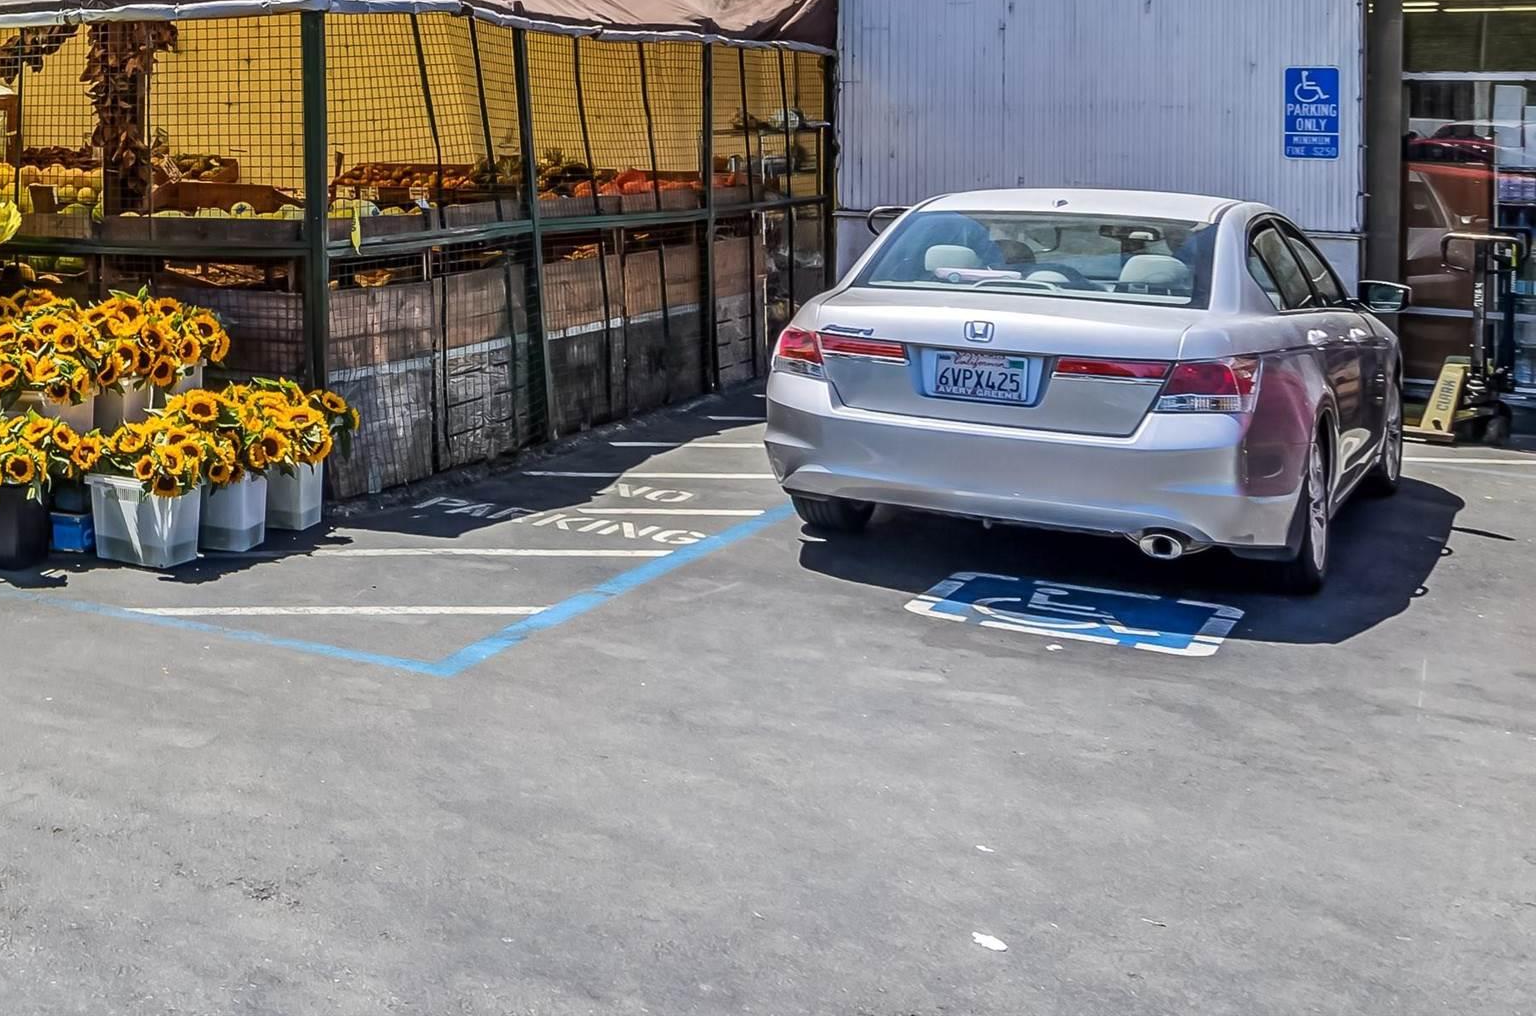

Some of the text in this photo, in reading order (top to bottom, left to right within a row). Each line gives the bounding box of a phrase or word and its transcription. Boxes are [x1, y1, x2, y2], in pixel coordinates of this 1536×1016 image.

[1287, 104, 1336, 117] PARKING
[1296, 118, 1327, 131] ONLY
[1293, 136, 1331, 145] MINIMUM
[1286, 146, 1305, 155] FINE
[939, 367, 1020, 392] 6VPX425
[938, 386, 1020, 399] AVERY GREENE
[1437, 380, 1455, 411] CLARK
[597, 482, 694, 503] NO
[412, 496, 710, 544] PARKING
